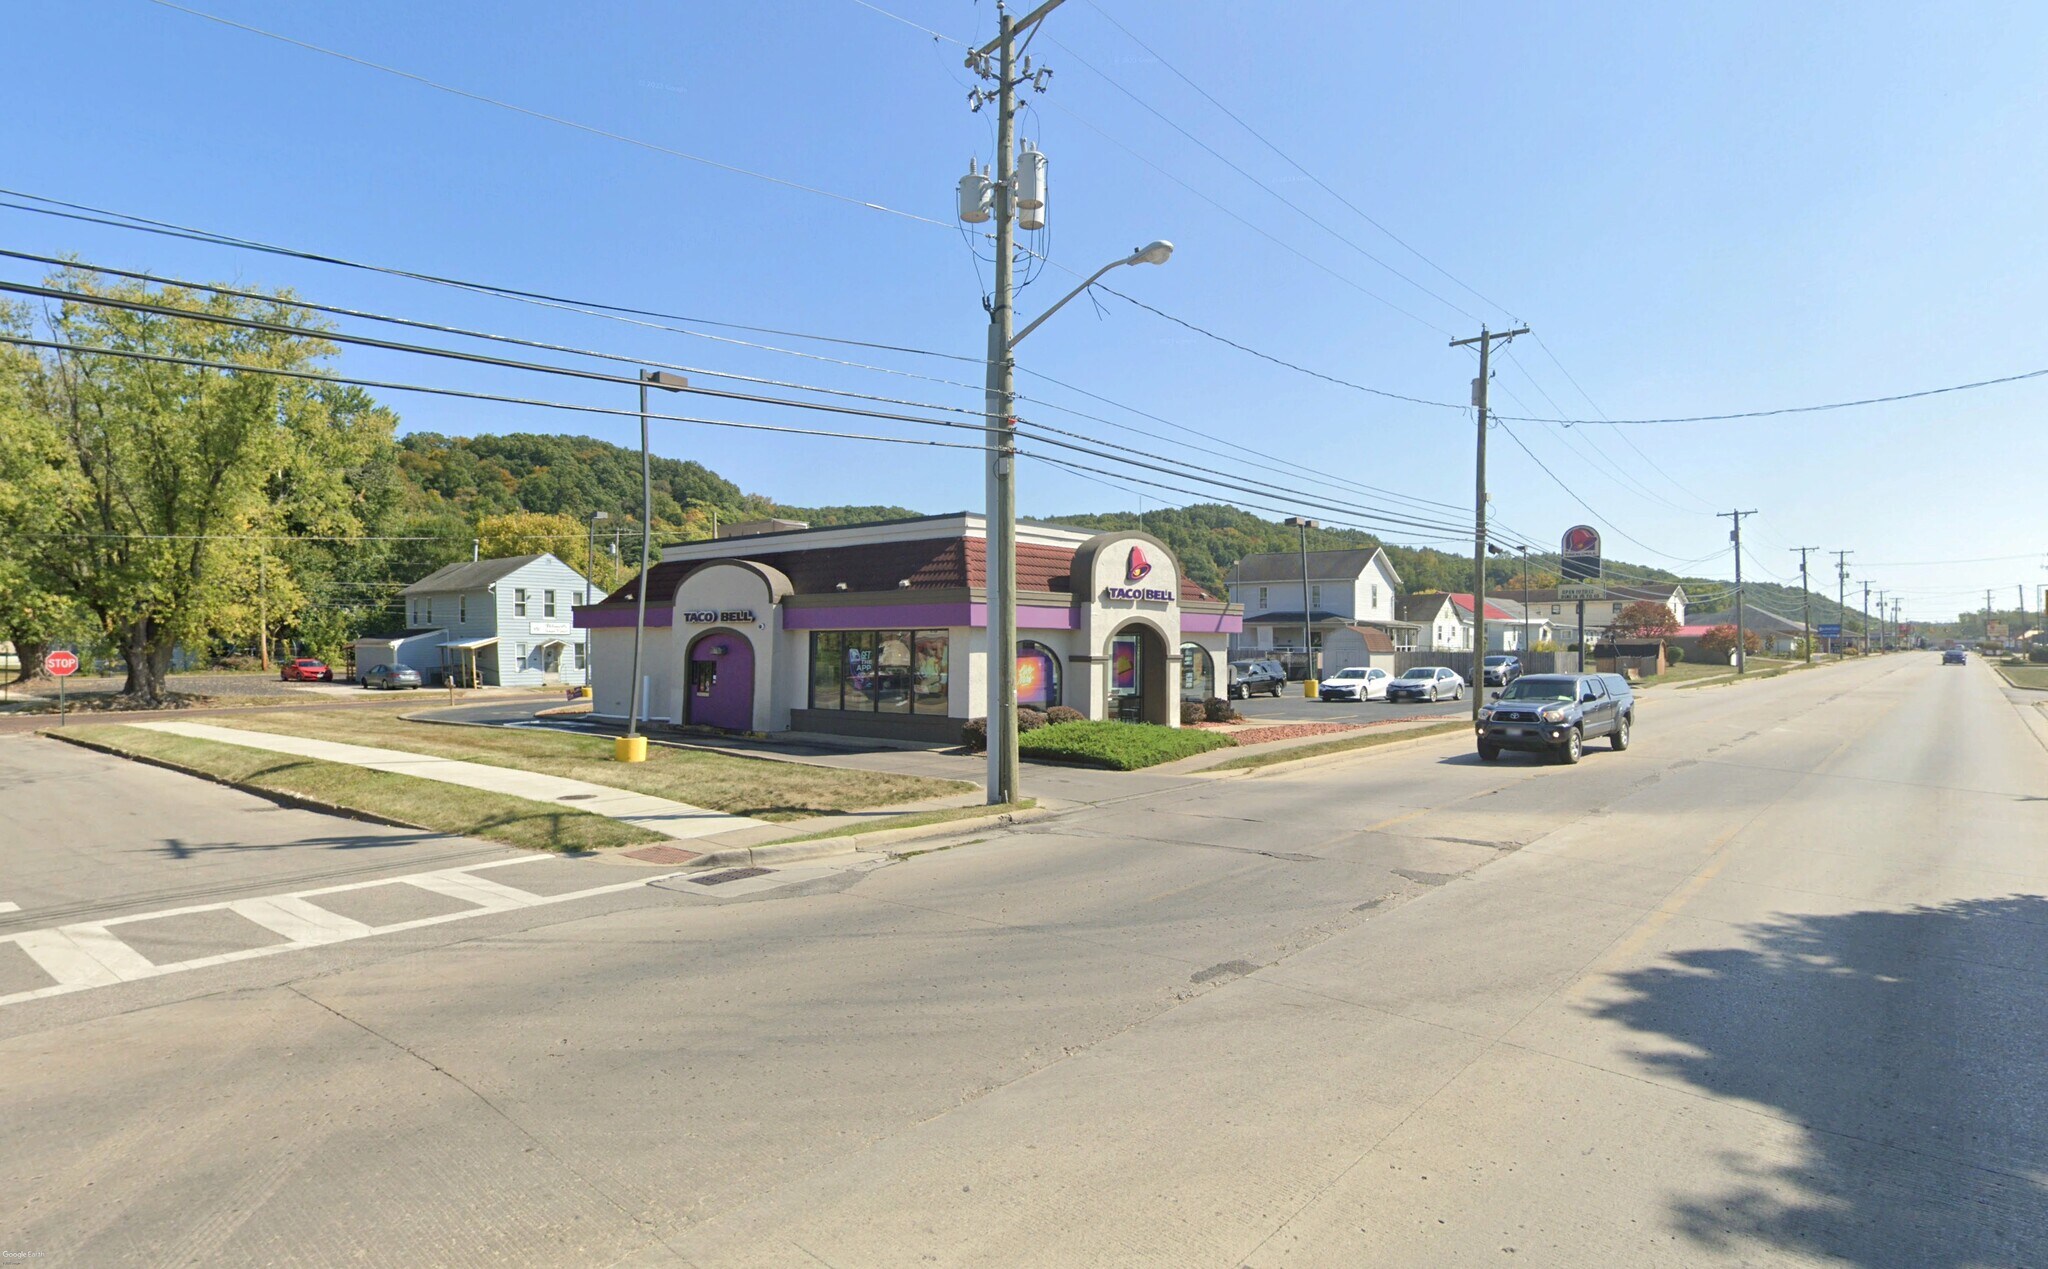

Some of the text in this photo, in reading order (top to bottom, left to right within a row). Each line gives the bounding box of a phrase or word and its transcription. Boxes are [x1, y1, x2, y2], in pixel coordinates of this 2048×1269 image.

[1110, 588, 1175, 601] TACO BELL
[684, 611, 752, 623] TACO BELL
[860, 651, 871, 660] GET
[48, 658, 76, 668] STOP
